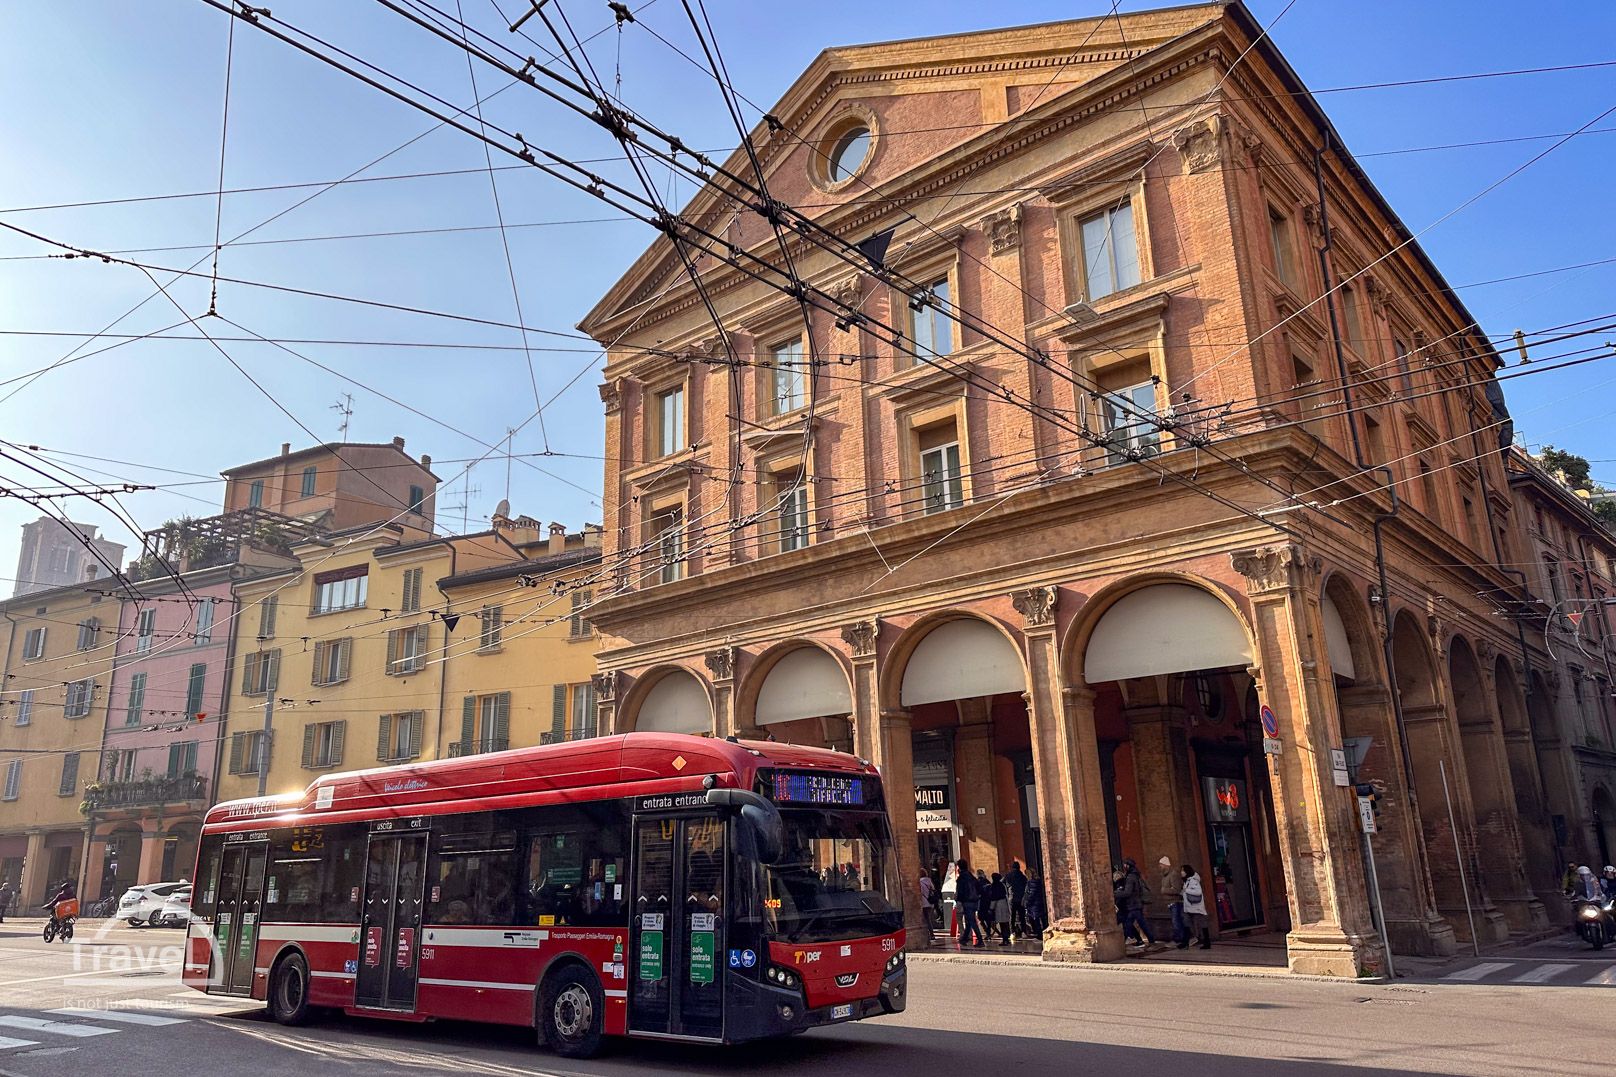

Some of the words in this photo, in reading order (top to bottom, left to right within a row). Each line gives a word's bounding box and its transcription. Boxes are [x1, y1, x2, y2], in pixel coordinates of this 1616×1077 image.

[642, 796, 673, 809] entrata
[675, 794, 708, 806] entranc
[376, 820, 394, 831] uscita
[410, 817, 422, 828] exit
[228, 833, 244, 841] entrata
[249, 832, 268, 840] entrance
[881, 938, 896, 953] 5911
[421, 948, 435, 960] 5911
